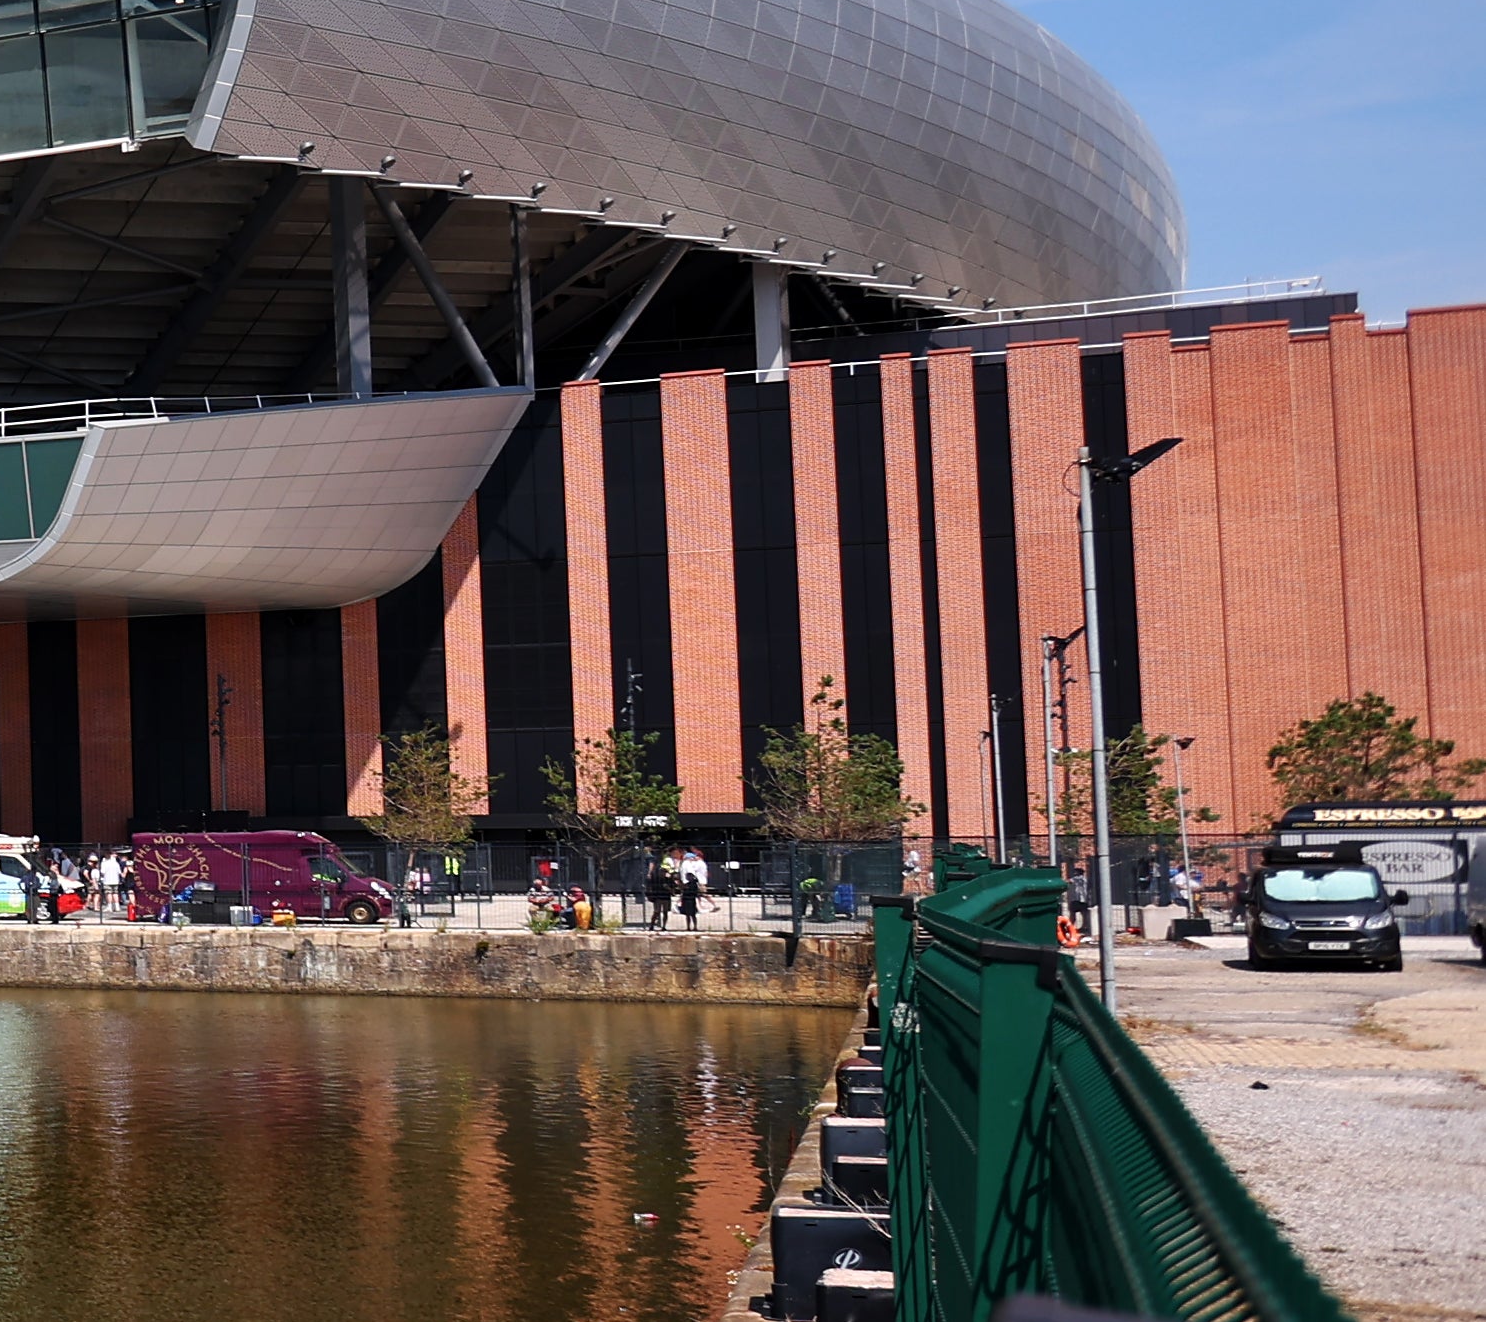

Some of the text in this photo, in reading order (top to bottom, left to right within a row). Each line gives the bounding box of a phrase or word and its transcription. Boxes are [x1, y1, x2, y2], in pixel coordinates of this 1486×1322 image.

[1312, 808, 1445, 821] ESPRESSO
[133, 844, 152, 862] THE
[153, 835, 185, 845] MOO
[186, 843, 210, 880] SHACK
[1361, 851, 1452, 862] ESPRESSO
[1385, 863, 1425, 874] BAR
